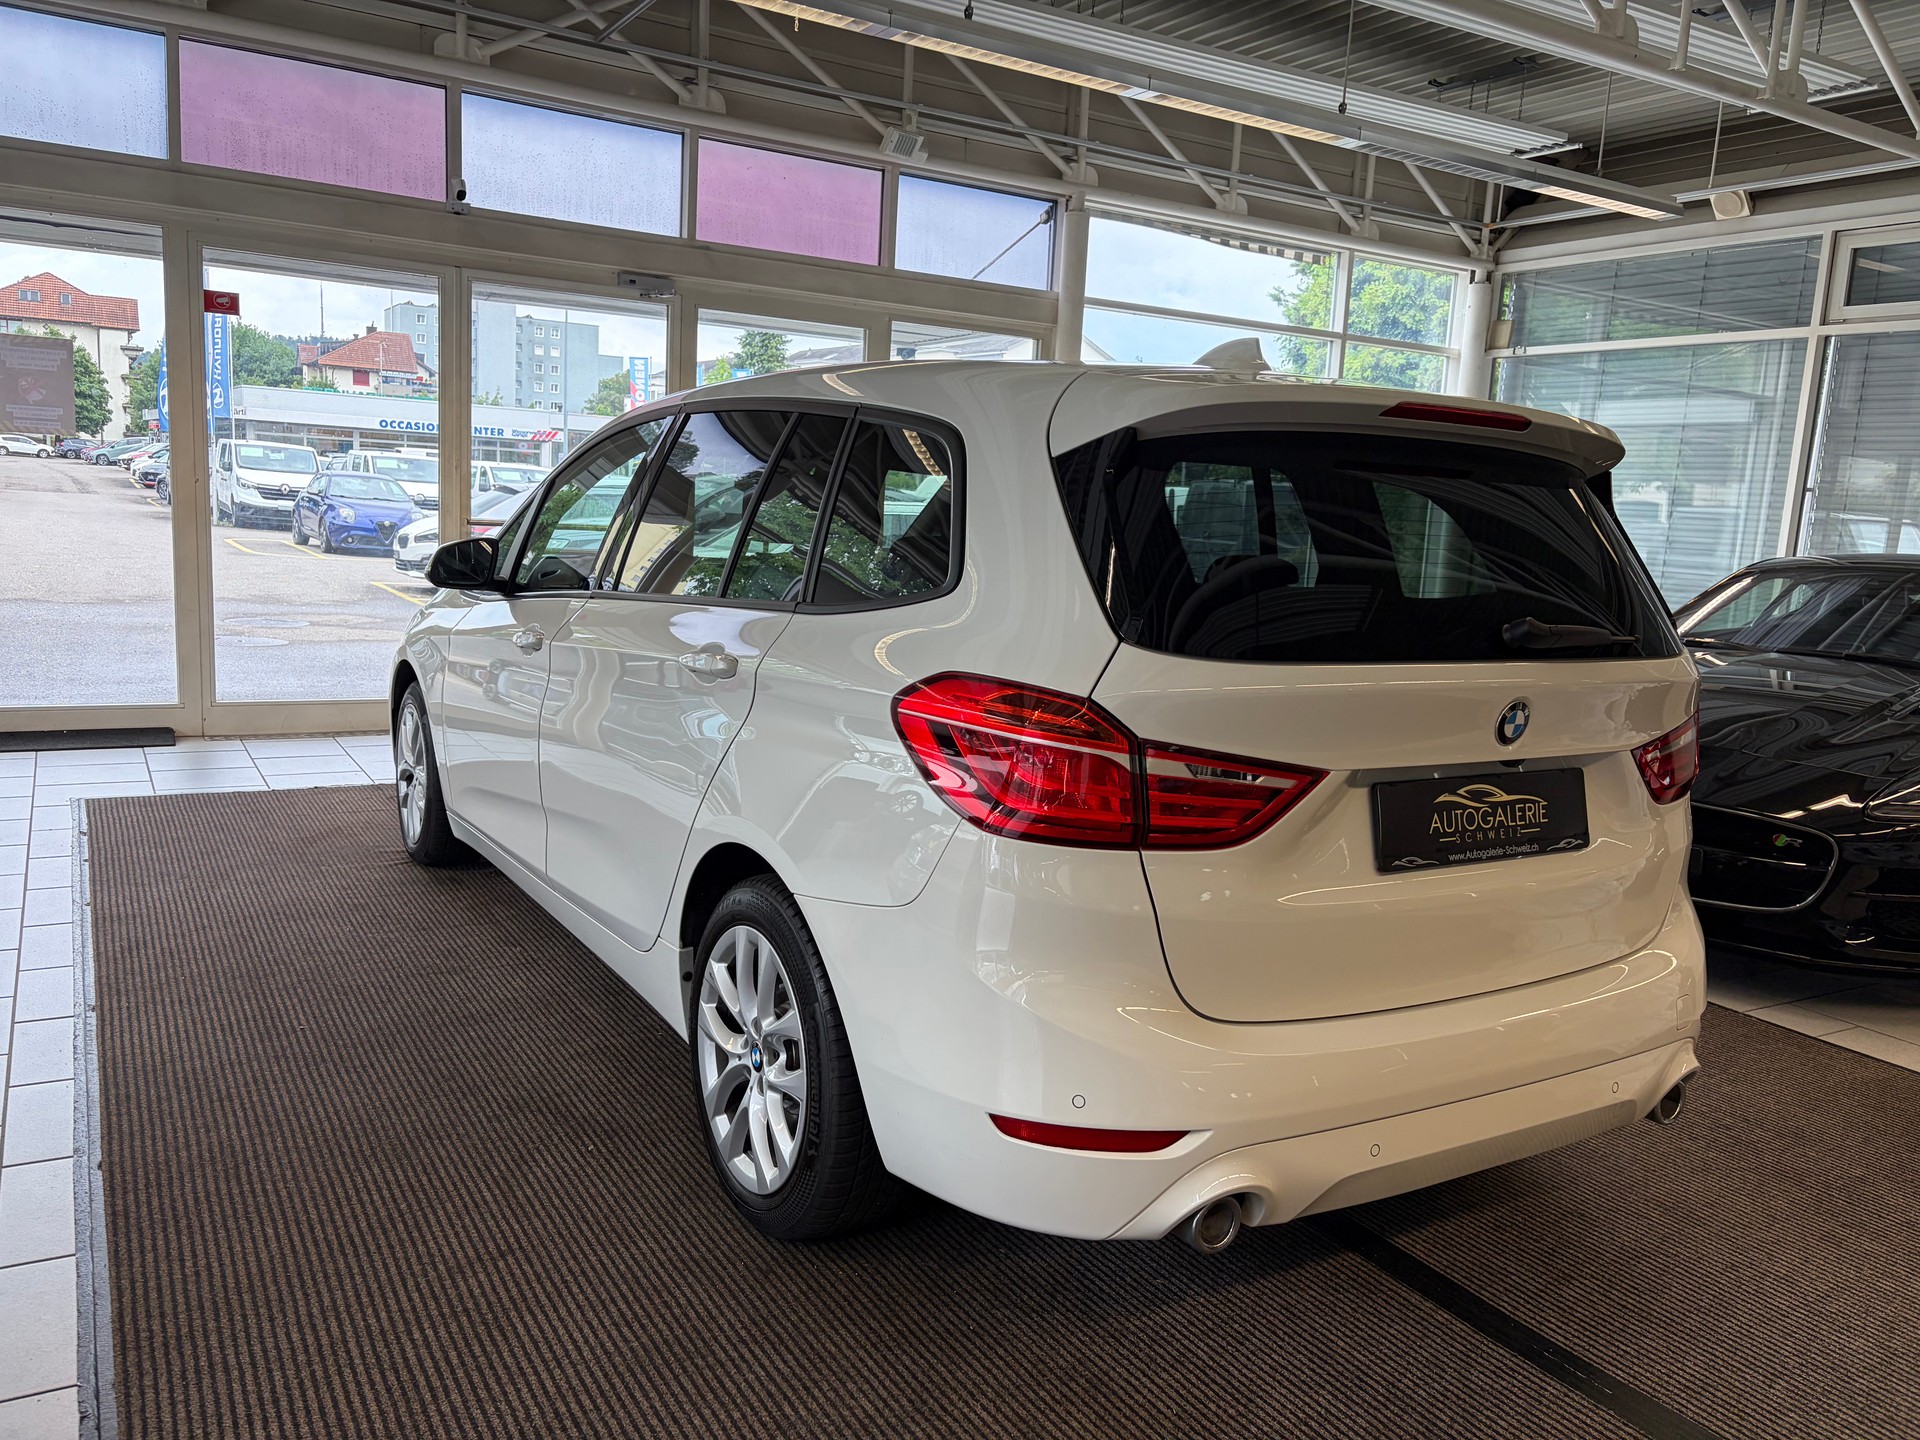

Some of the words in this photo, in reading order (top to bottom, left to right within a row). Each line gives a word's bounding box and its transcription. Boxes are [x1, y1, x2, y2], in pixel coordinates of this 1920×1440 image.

[379, 419, 439, 432] OCCASIO
[474, 426, 505, 437] NTER
[1429, 802, 1549, 834] AUTOGALERIE
[1455, 826, 1521, 844] SCHWEIZ
[1448, 843, 1540, 861] www.Autogalerie-Schweiz.ch
